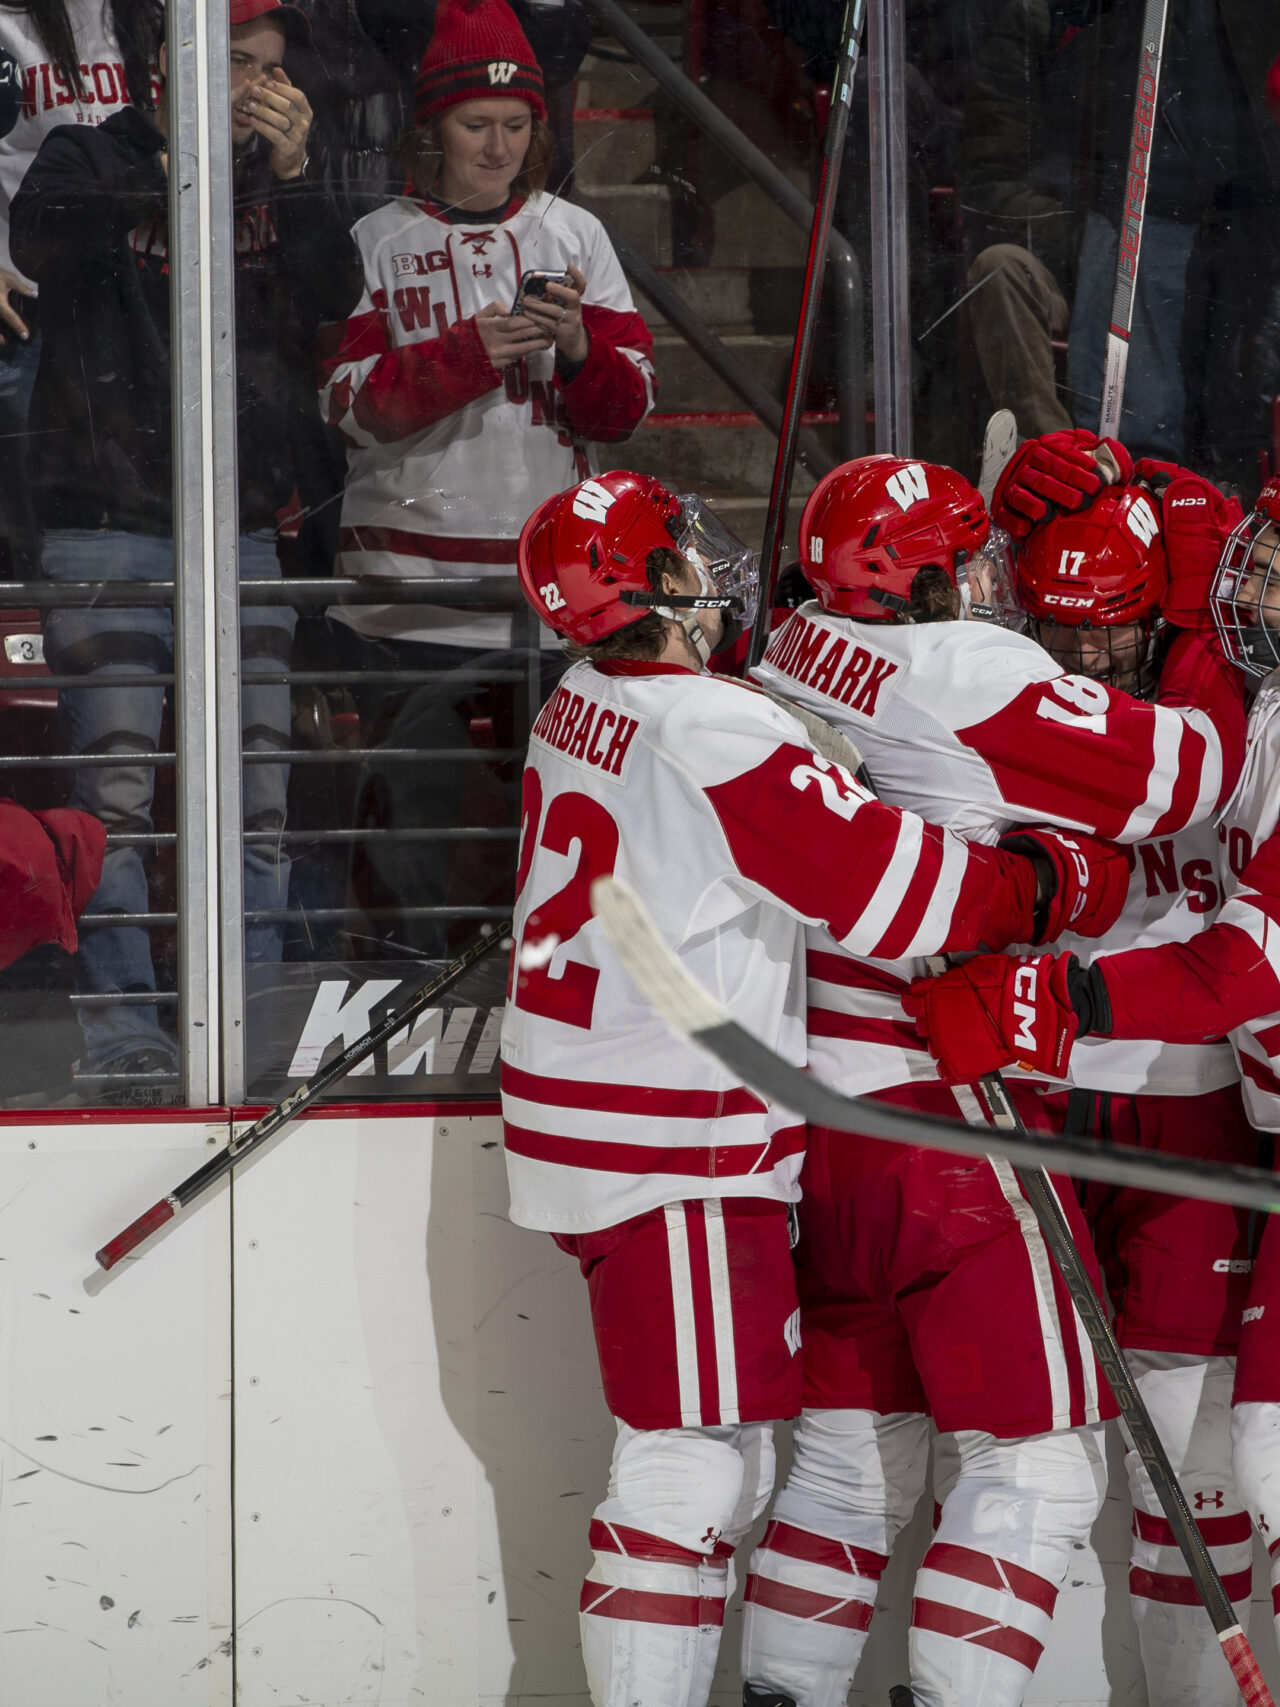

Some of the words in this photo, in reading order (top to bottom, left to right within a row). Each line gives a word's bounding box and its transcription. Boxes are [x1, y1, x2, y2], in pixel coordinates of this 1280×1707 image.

[1119, 74, 1156, 279] JETSPEED
[573, 480, 617, 525] W
[885, 464, 930, 513] W
[1172, 498, 1207, 507] CCM
[1127, 496, 1159, 549] W
[811, 536, 823, 564] 18
[1058, 550, 1085, 576] 17
[539, 583, 567, 612] 22
[694, 600, 731, 608] CCM
[972, 607, 993, 616] CCM
[1044, 594, 1095, 608] CCM
[21, 641, 34, 661] 3
[415, 918, 513, 1000] JETSPEED
